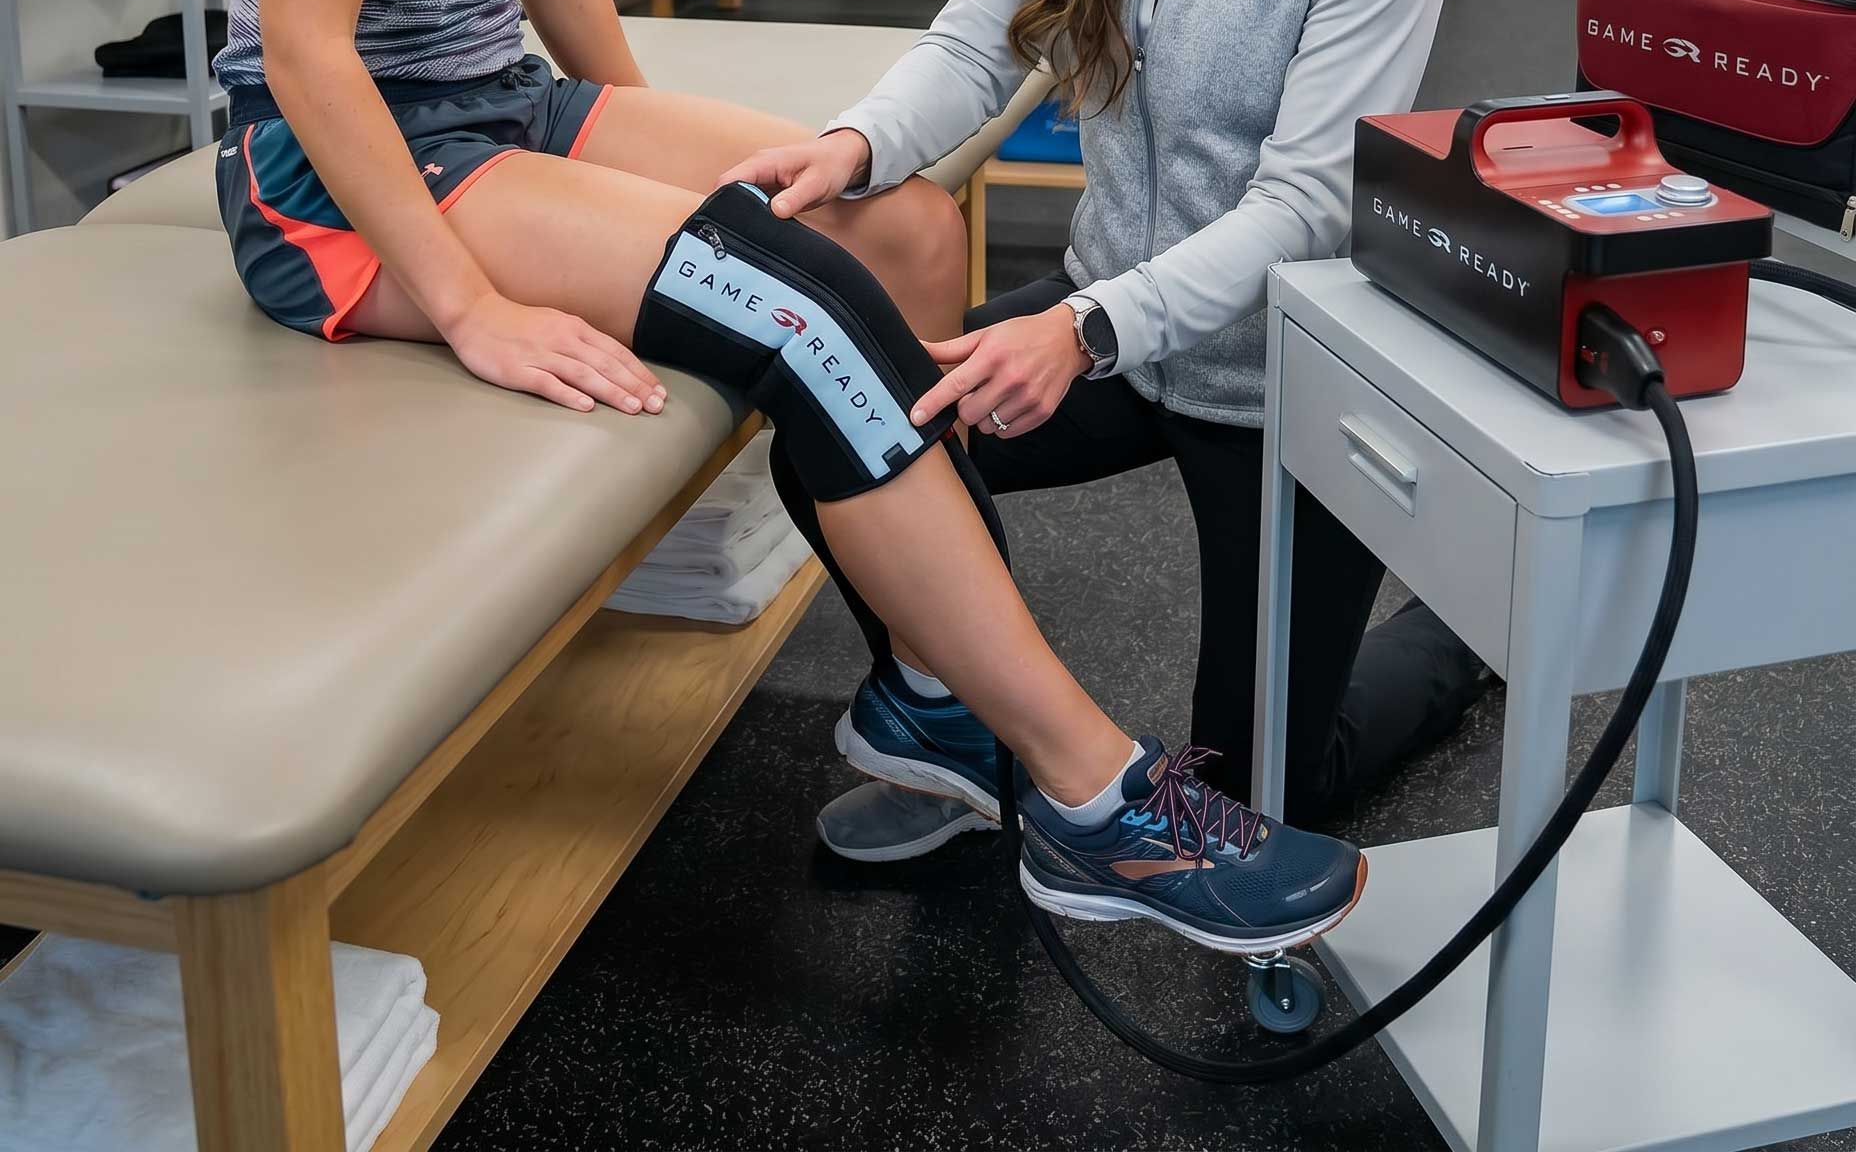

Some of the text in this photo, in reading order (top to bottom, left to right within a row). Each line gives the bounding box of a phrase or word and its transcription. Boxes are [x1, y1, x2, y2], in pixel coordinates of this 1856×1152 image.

[1587, 19, 1823, 91] GAME READY
[1373, 197, 1528, 297] GAME READY
[678, 260, 884, 424] GAME READY
